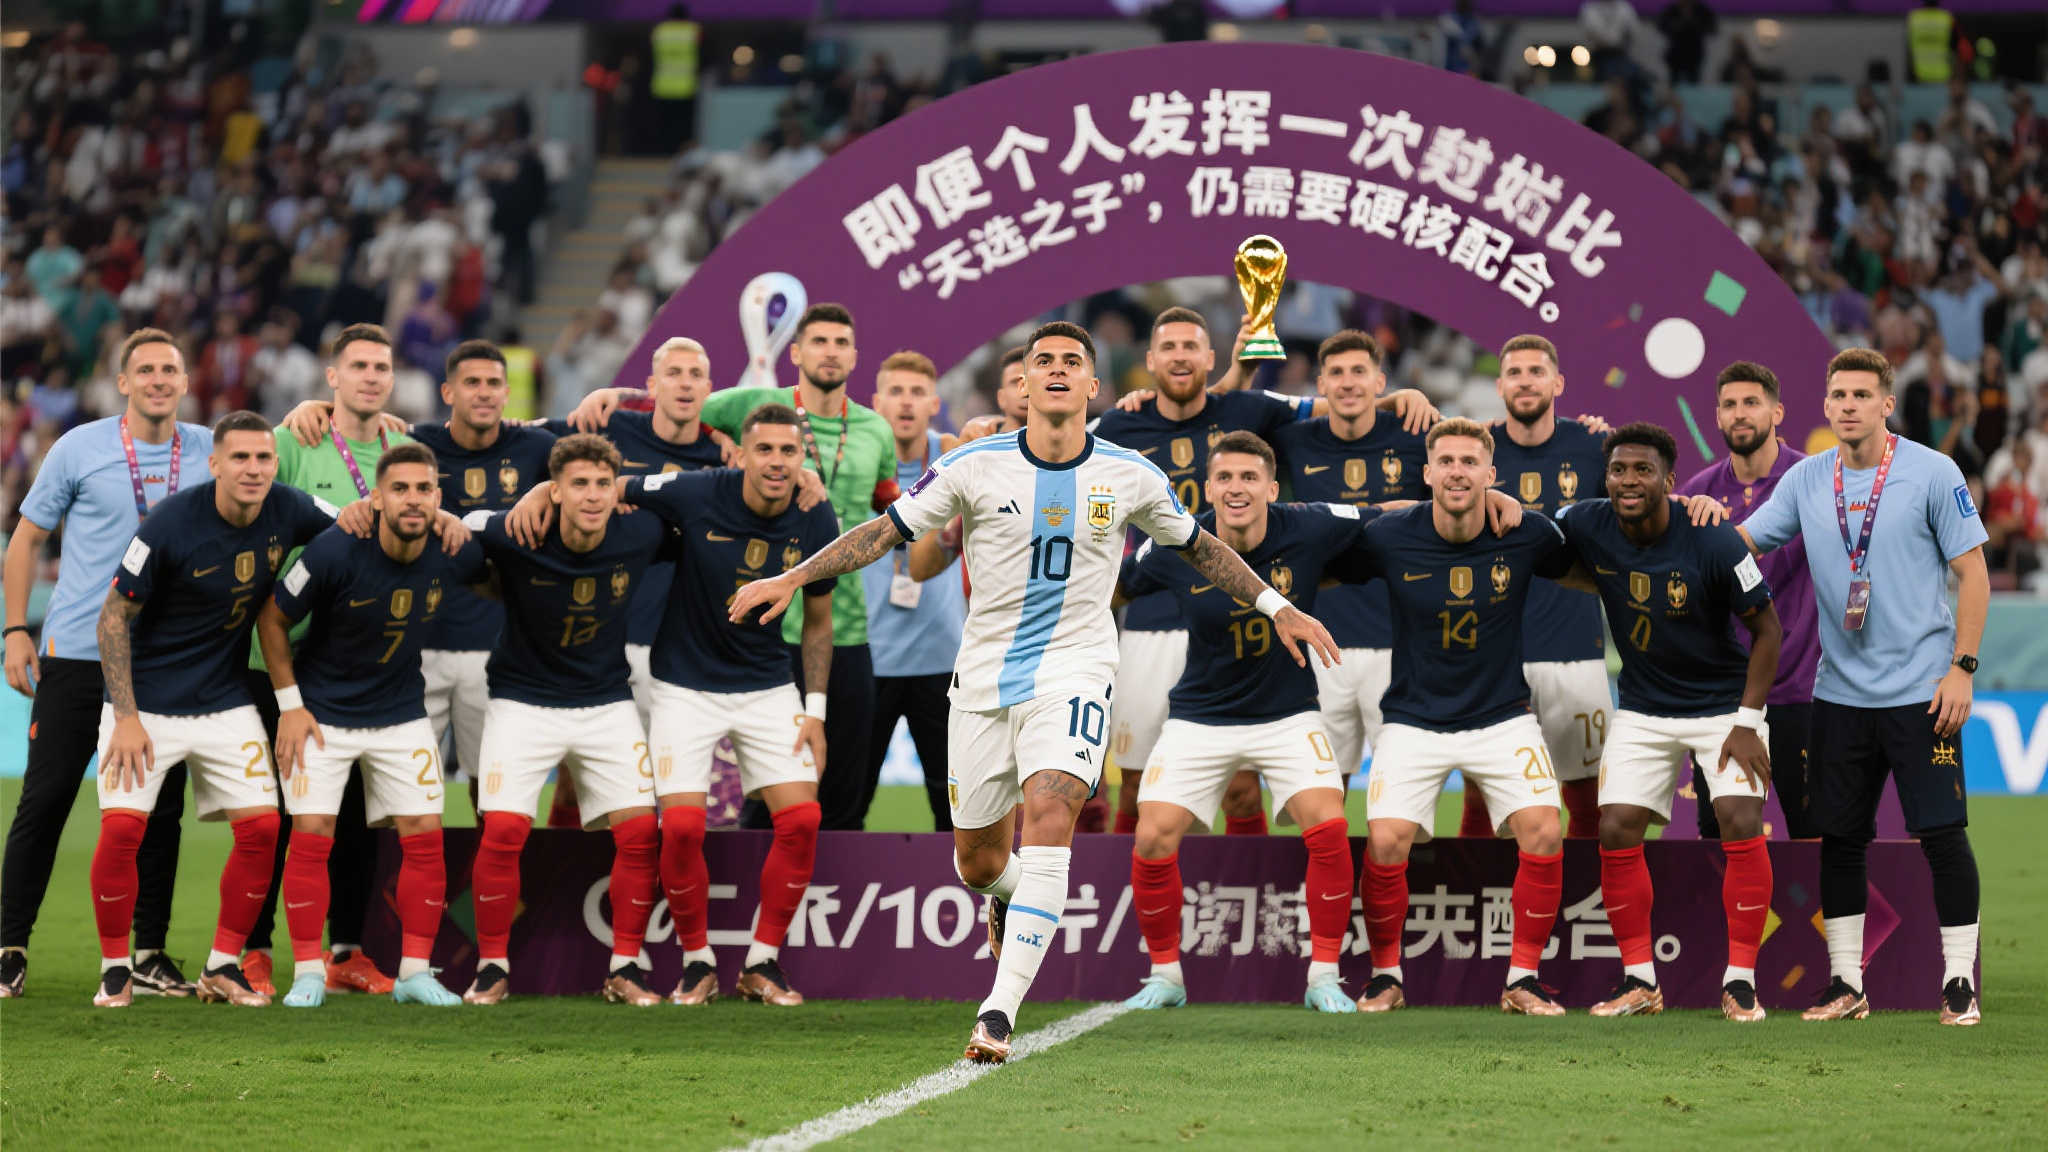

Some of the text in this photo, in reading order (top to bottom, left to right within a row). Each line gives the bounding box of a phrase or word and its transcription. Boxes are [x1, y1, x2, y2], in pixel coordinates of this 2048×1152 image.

[1030, 535, 1074, 581] 10
[223, 595, 254, 630] 5
[377, 630, 405, 664] 7
[1229, 617, 1271, 659] 19
[1067, 696, 1106, 747] 10
